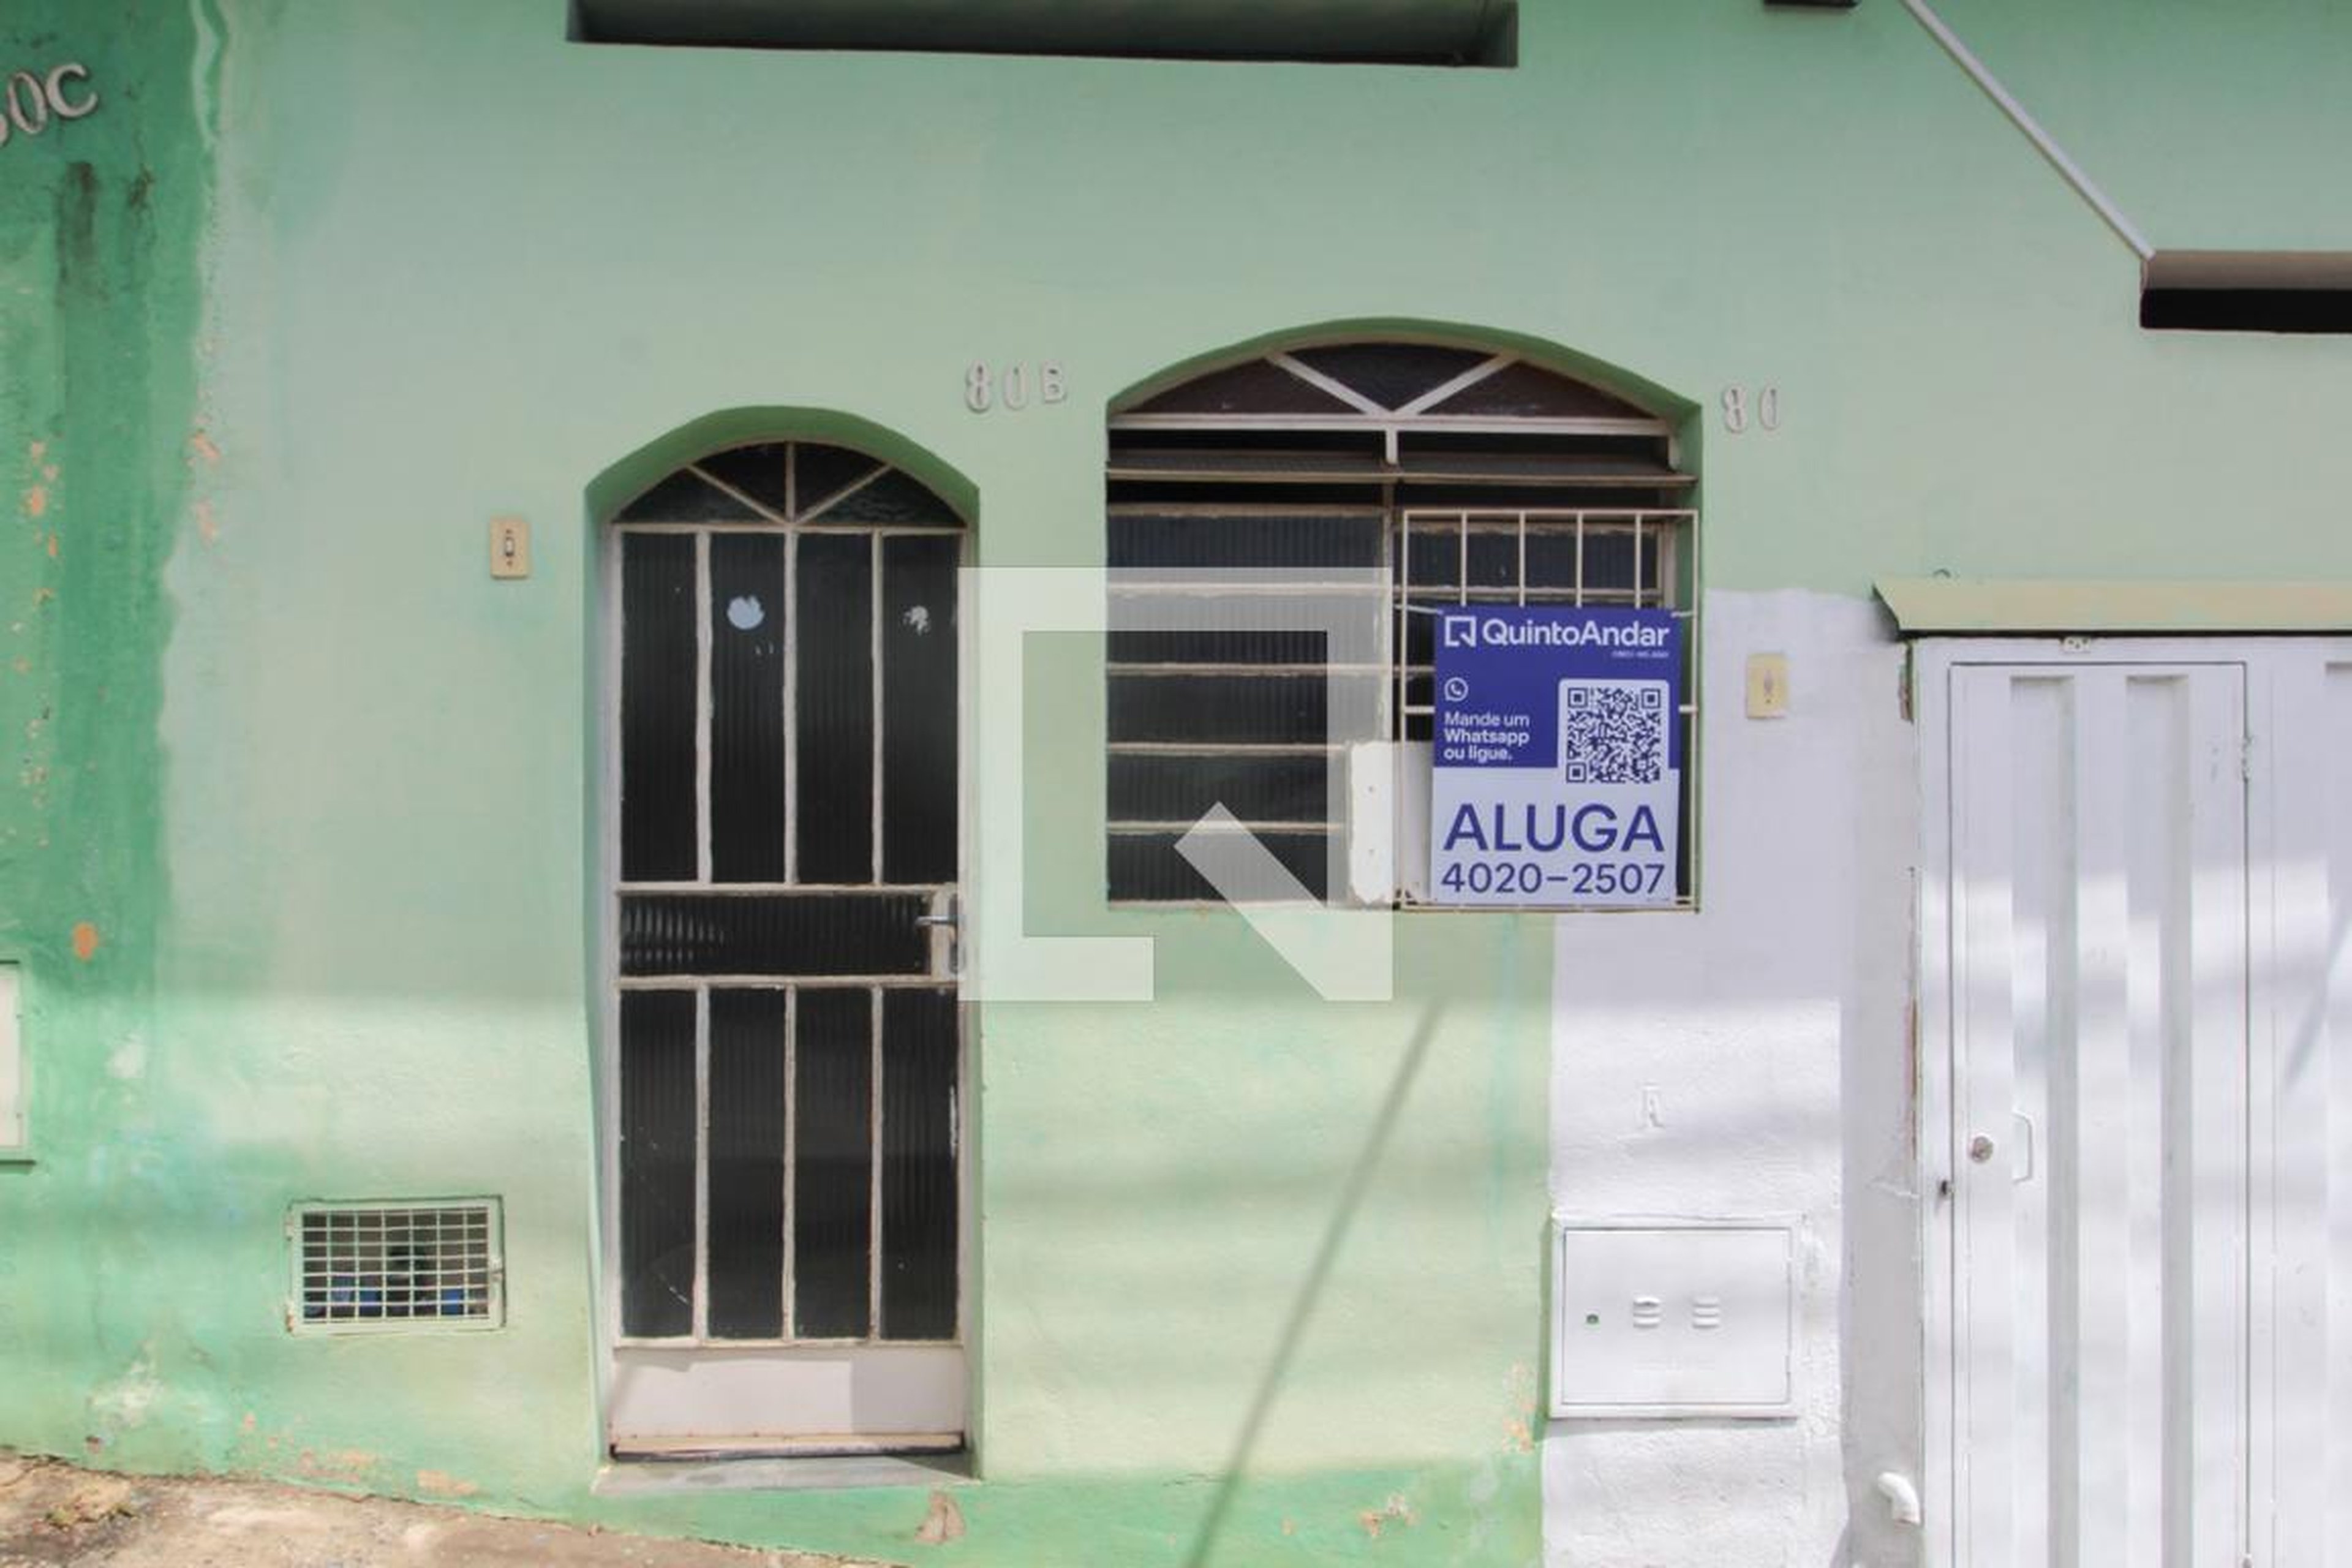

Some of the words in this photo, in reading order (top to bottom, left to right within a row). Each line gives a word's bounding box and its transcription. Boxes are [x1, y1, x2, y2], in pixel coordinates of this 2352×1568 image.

[0, 63, 98, 146] 0C
[1723, 383, 1778, 432] 80
[1482, 618, 1670, 647] QuintoAndar
[1444, 711, 1501, 727] Mande
[1503, 715, 1530, 727] um
[1444, 728, 1530, 747] Whatsapp
[1444, 748, 1464, 760] ou
[1469, 745, 1513, 763] ligue.
[1443, 803, 1665, 852] ALUGA
[1441, 862, 1665, 894] 4020-2507
